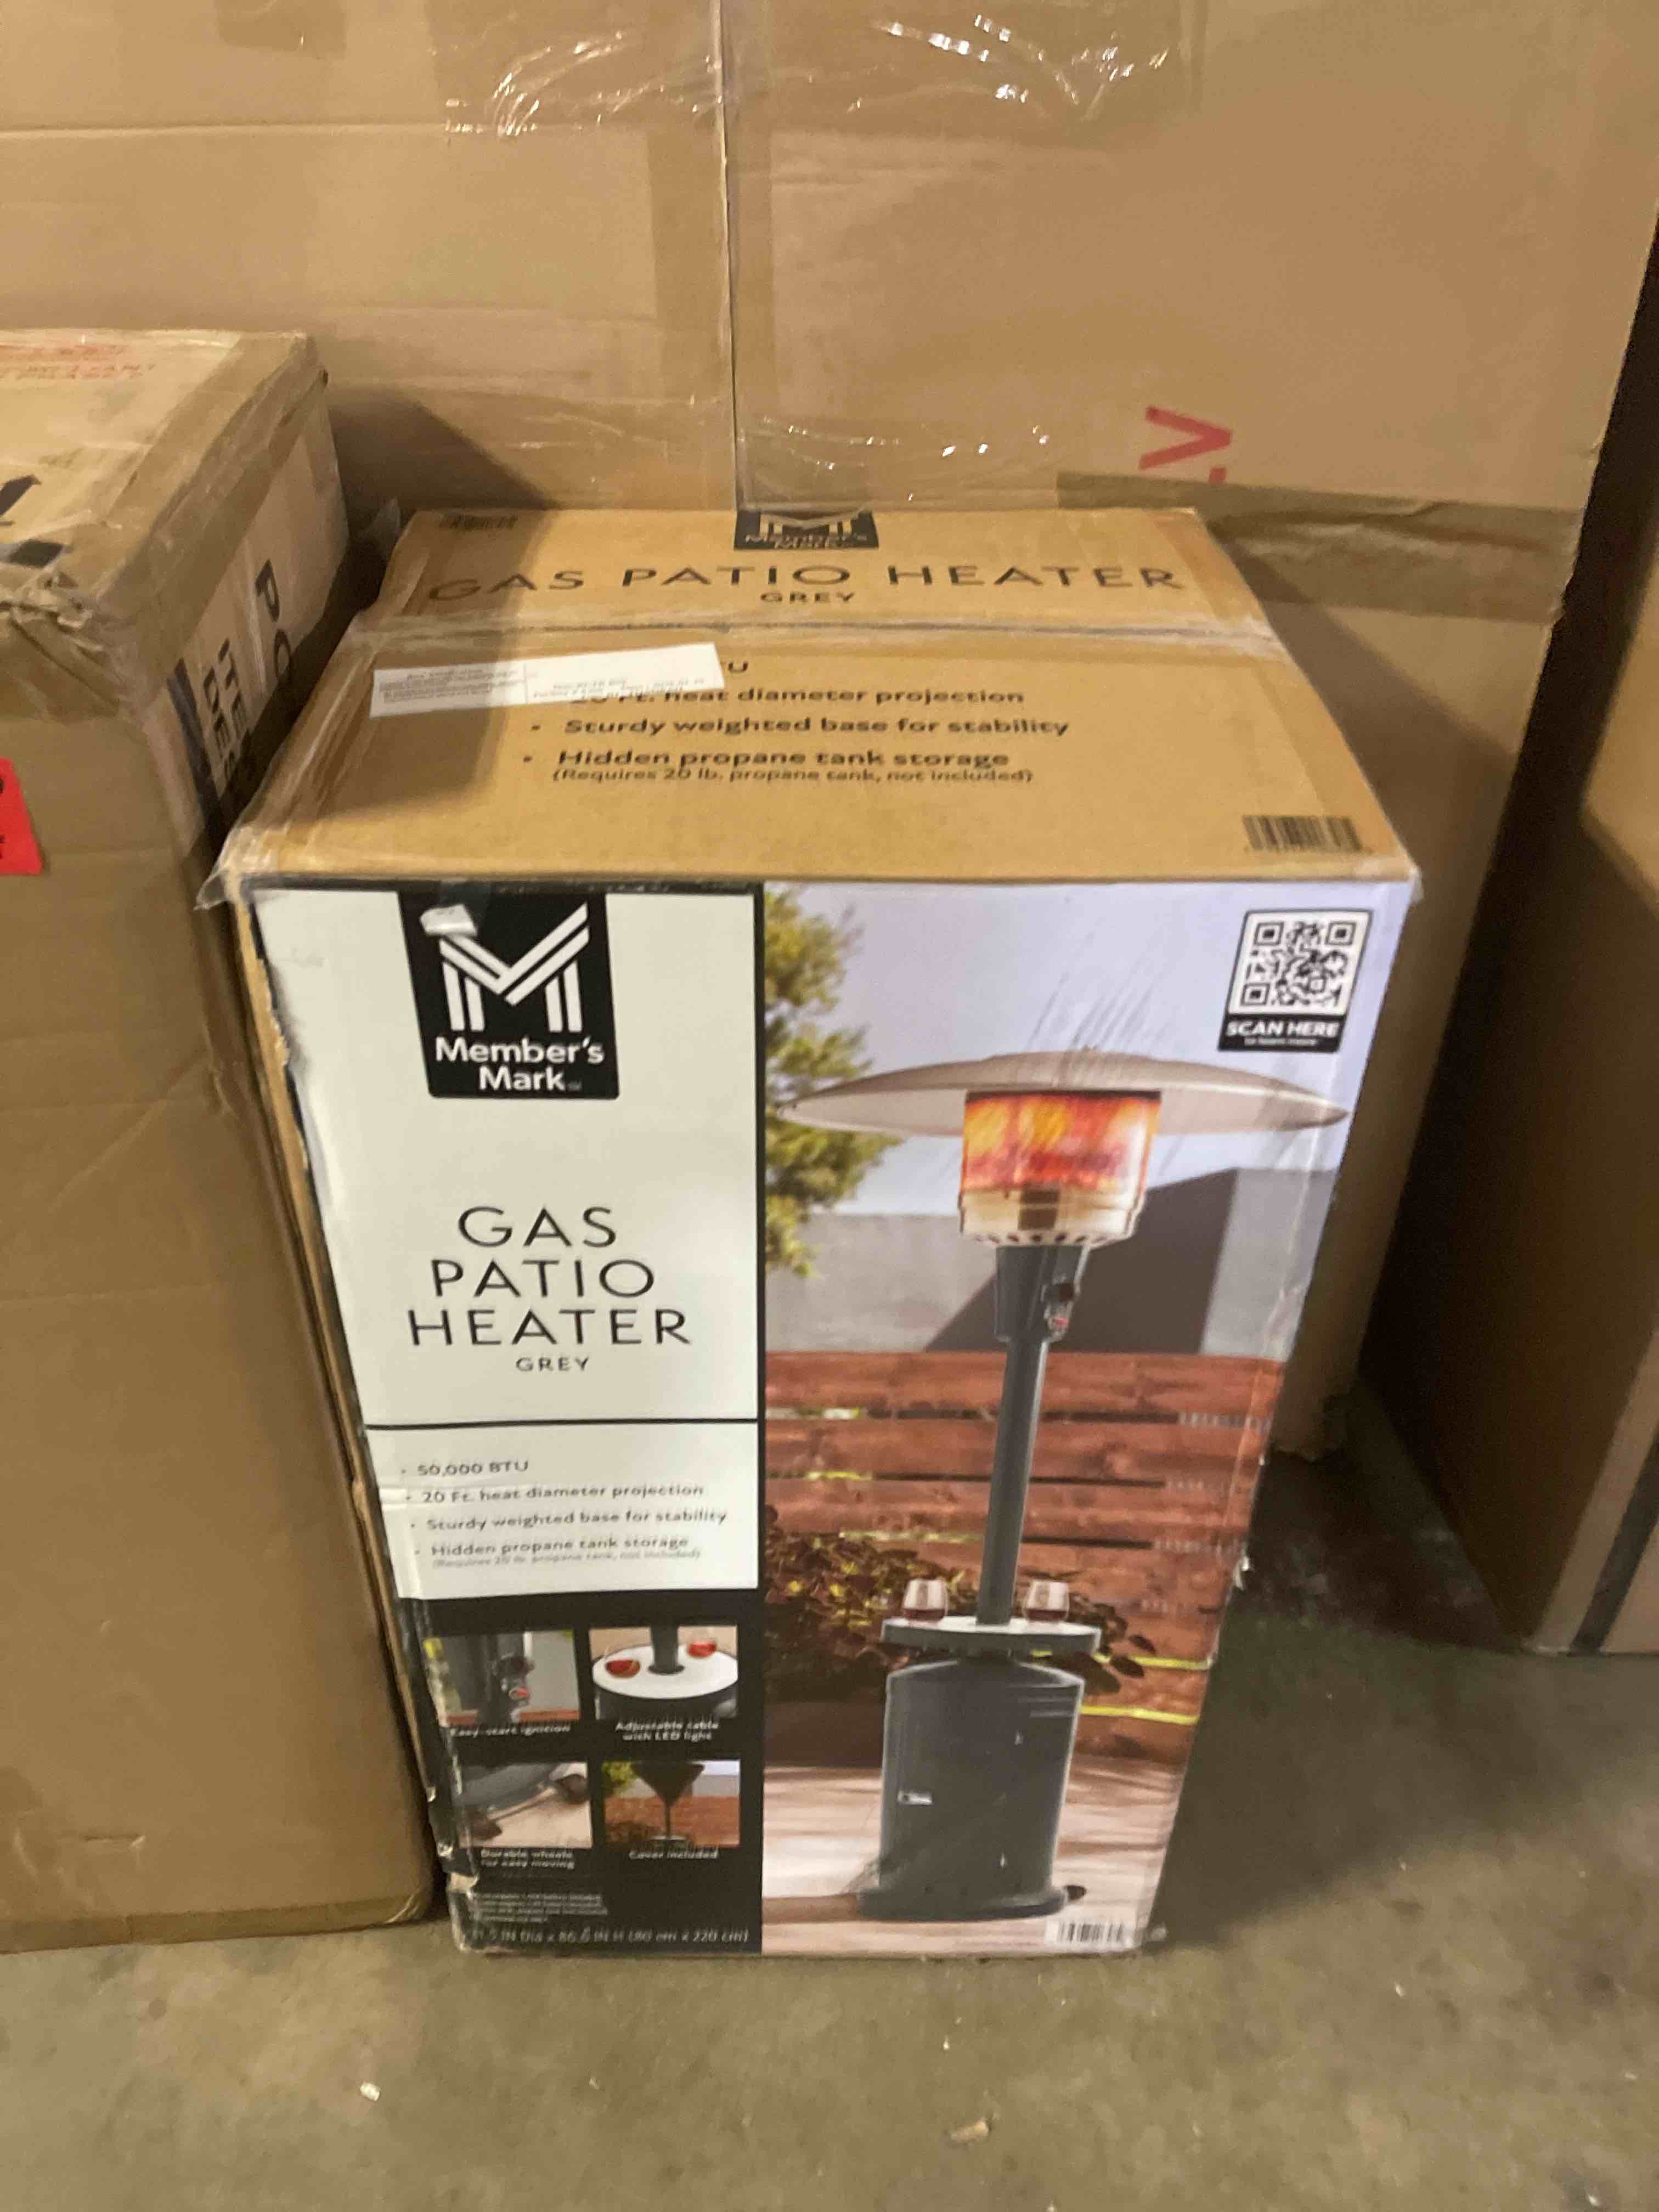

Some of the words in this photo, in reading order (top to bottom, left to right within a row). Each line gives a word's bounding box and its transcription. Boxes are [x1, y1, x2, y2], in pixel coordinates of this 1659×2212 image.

[429, 570, 584, 601] GAS
[622, 566, 850, 586] PATIO
[887, 565, 1185, 589] HEATER
[760, 592, 855, 603] GREY
[664, 689, 728, 702] heat
[737, 688, 867, 702] diameter
[876, 689, 1024, 706] projection
[564, 719, 665, 736] Sturdy
[674, 717, 811, 736] weighted
[821, 718, 888, 732] base
[898, 718, 940, 732] for
[947, 719, 1070, 736] stability
[558, 749, 670, 765] Hidden
[680, 752, 806, 768] propane
[816, 749, 884, 765] tank
[893, 752, 1010, 769] storage
[552, 768, 657, 783] (Requires
[663, 769, 690, 780] 20
[730, 771, 820, 783] propane
[826, 769, 881, 783] tank,
[887, 770, 925, 781] not
[930, 769, 1034, 783] included)
[1226, 1020, 1284, 1036] SCAN
[1286, 1020, 1340, 1038] HERE
[435, 1036, 605, 1064] Member's
[478, 1065, 566, 1091] Mark
[458, 1205, 617, 1248] GAS
[431, 1259, 655, 1298] PATIO
[408, 1309, 691, 1346] HEATER
[516, 1357, 590, 1372] GREY
[417, 1463, 483, 1477] 50,000
[489, 1460, 529, 1473] BTU
[422, 1491, 444, 1503] 20
[480, 1487, 521, 1501] heat
[526, 1485, 605, 1498] diameter
[612, 1483, 703, 1499] projection
[426, 1517, 487, 1532] Sturdy
[491, 1512, 575, 1528] weighted
[579, 1511, 619, 1523] base
[625, 1509, 650, 1522] for
[656, 1509, 727, 1525] stability
[431, 1544, 496, 1556] Hidden
[501, 1541, 574, 1555] propane
[579, 1537, 618, 1549] tank
[624, 1537, 689, 1550] storage
